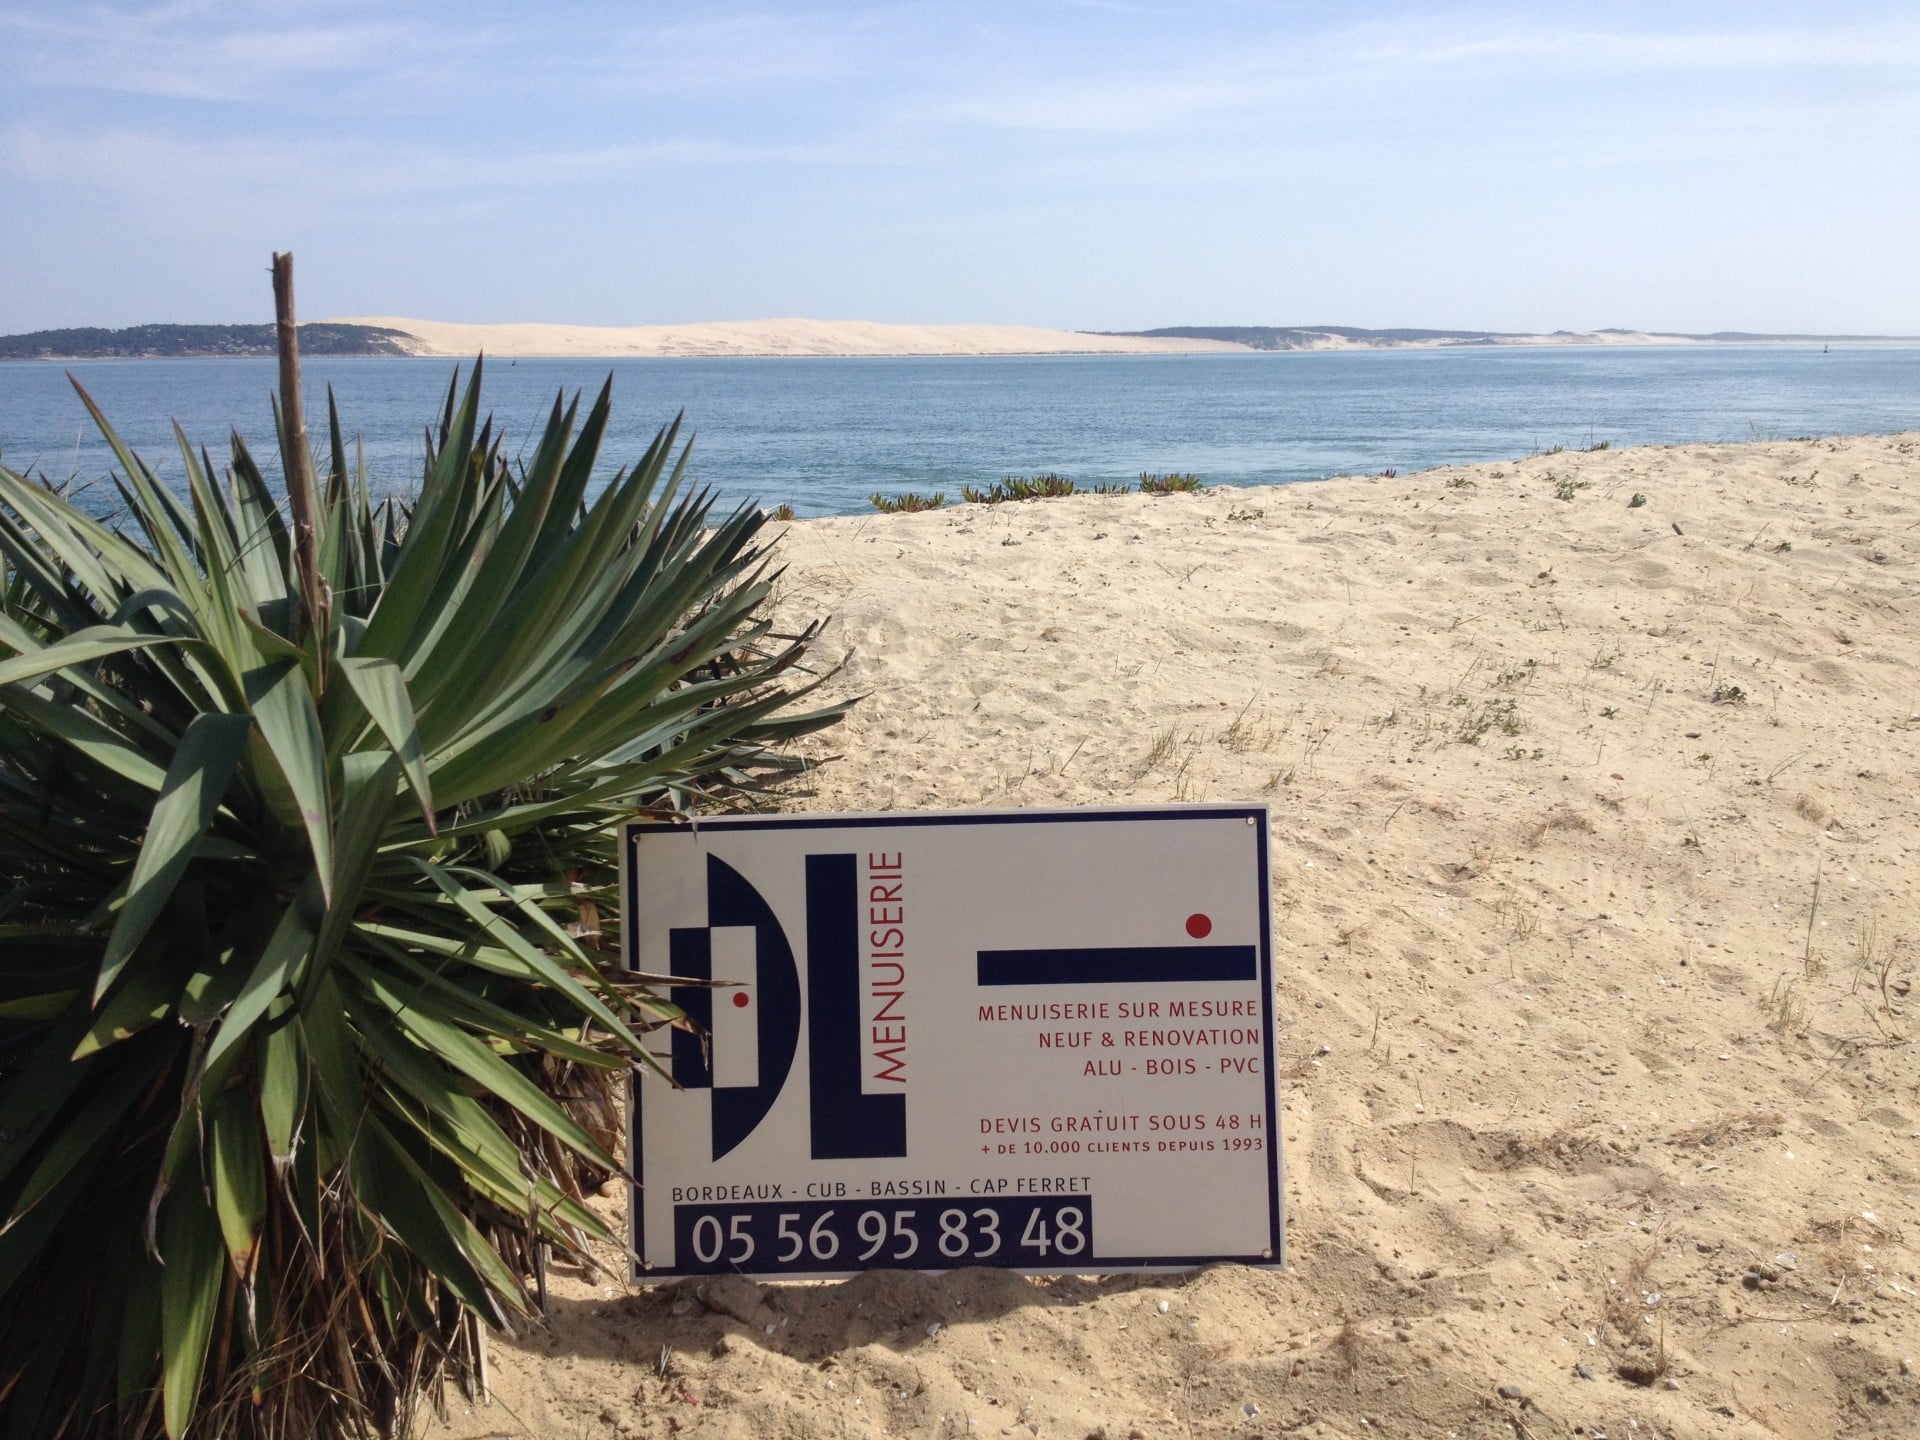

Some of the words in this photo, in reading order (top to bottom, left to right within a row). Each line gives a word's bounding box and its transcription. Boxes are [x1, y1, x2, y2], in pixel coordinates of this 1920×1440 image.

[869, 852, 907, 1083] MENUISERIE
[978, 1003, 1110, 1021] MENUISERIE
[1118, 1002, 1159, 1018] SUR
[1169, 1000, 1257, 1017] MESURE
[1039, 1031, 1093, 1048] NEUF
[1101, 1032, 1115, 1047] &
[1124, 1029, 1259, 1046] RENOVATION
[1084, 1060, 1122, 1076] ALU
[1146, 1059, 1196, 1075] BOIS
[1220, 1057, 1260, 1074] PVC
[980, 1118, 1041, 1134] DEVIS
[1051, 1115, 1140, 1132] GRATUIT
[1149, 1115, 1205, 1131] SOUS
[1215, 1114, 1240, 1130] 48
[1250, 1114, 1261, 1129] H
[998, 1144, 1016, 1155] DE
[1024, 1141, 1081, 1154] 10.000
[1087, 1141, 1151, 1153] CLIENTS
[1158, 1140, 1215, 1152] DEPUIS
[1223, 1138, 1263, 1151] 1993
[672, 1184, 783, 1202] BORDEAUX
[806, 1182, 846, 1199] CUB
[871, 1179, 946, 1197] BASSIN
[970, 1178, 1008, 1194] CAP
[1017, 1176, 1092, 1193] FERRET
[692, 1214, 756, 1264] 05
[777, 1210, 840, 1261] 56
[857, 1210, 919, 1262] 95
[938, 1208, 1001, 1259] 83
[1020, 1206, 1086, 1256] 48
